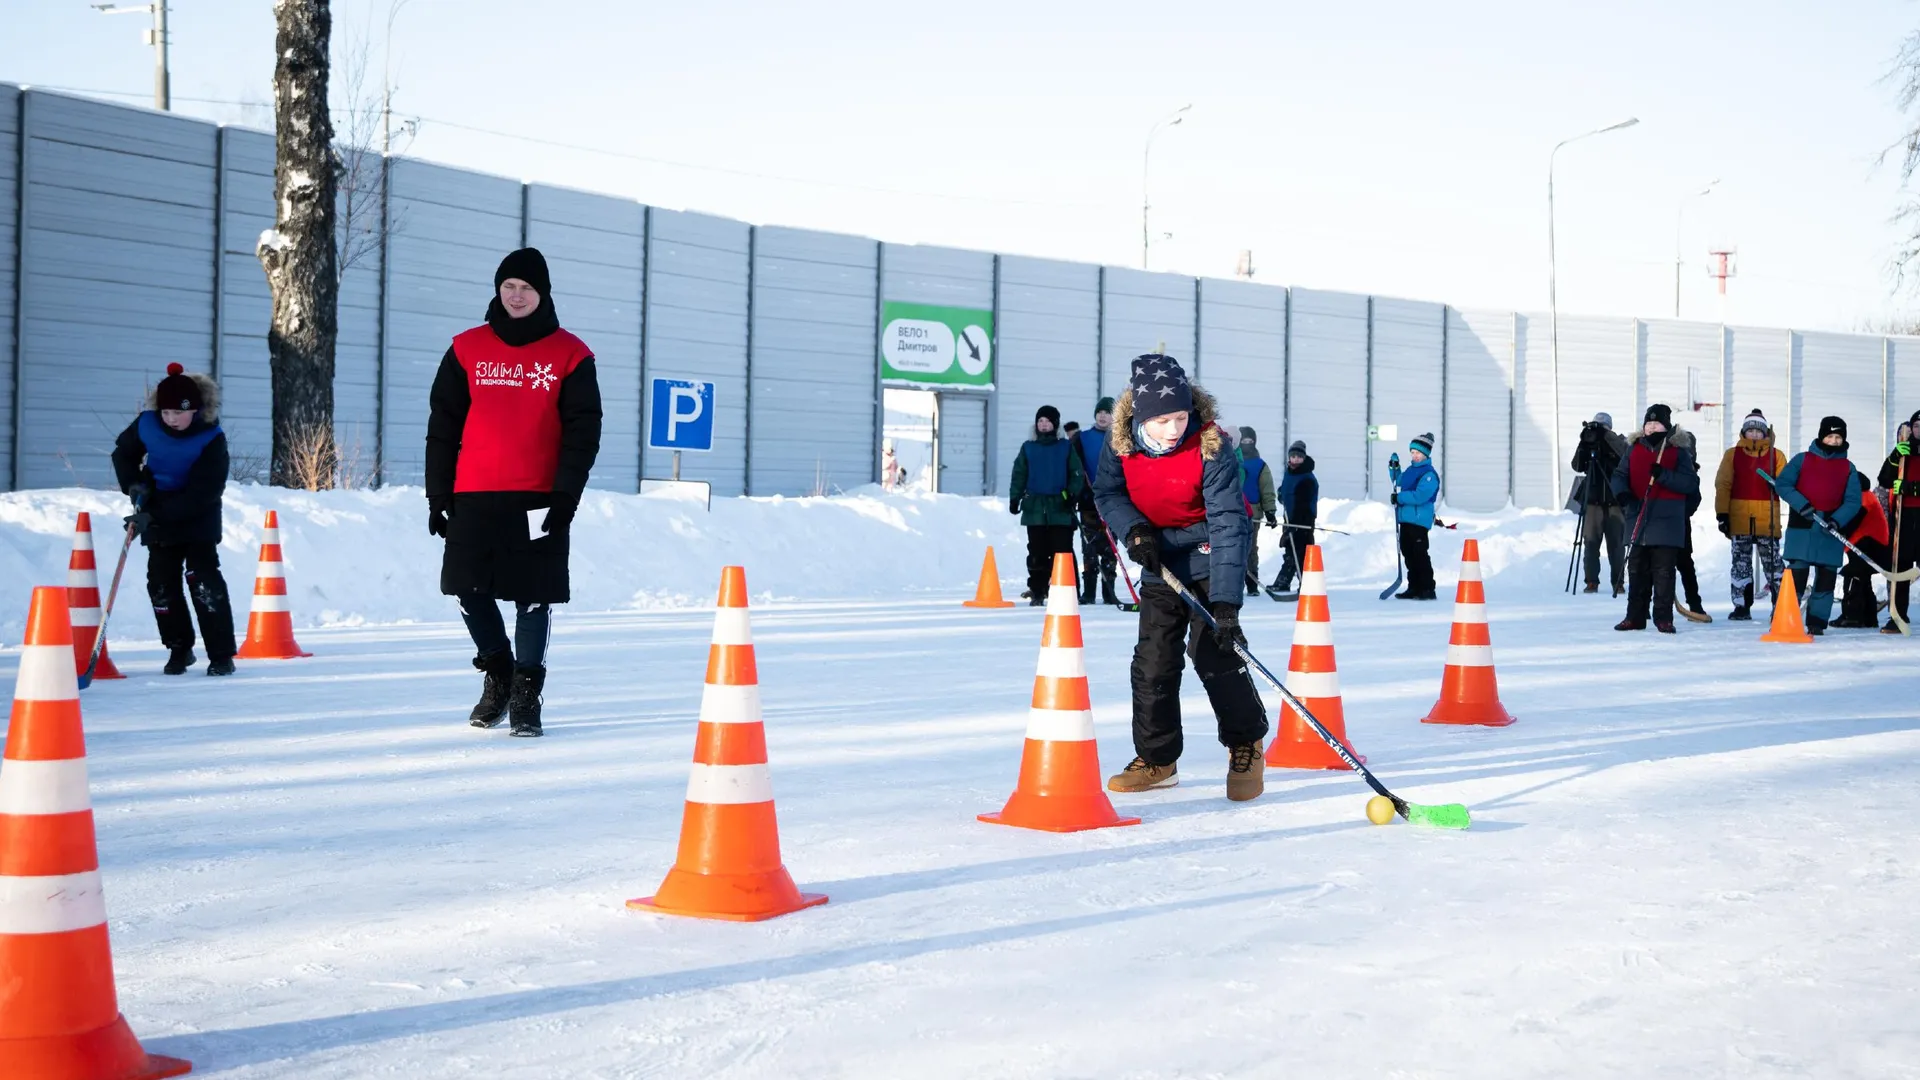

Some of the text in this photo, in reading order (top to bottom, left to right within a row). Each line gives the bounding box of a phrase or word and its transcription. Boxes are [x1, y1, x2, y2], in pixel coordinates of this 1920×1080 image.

[898, 326, 929, 339] ВЕЛО 1
[897, 339, 938, 353] Дмитров
[475, 361, 524, 379] ЗИМА
[667, 387, 703, 441] P
